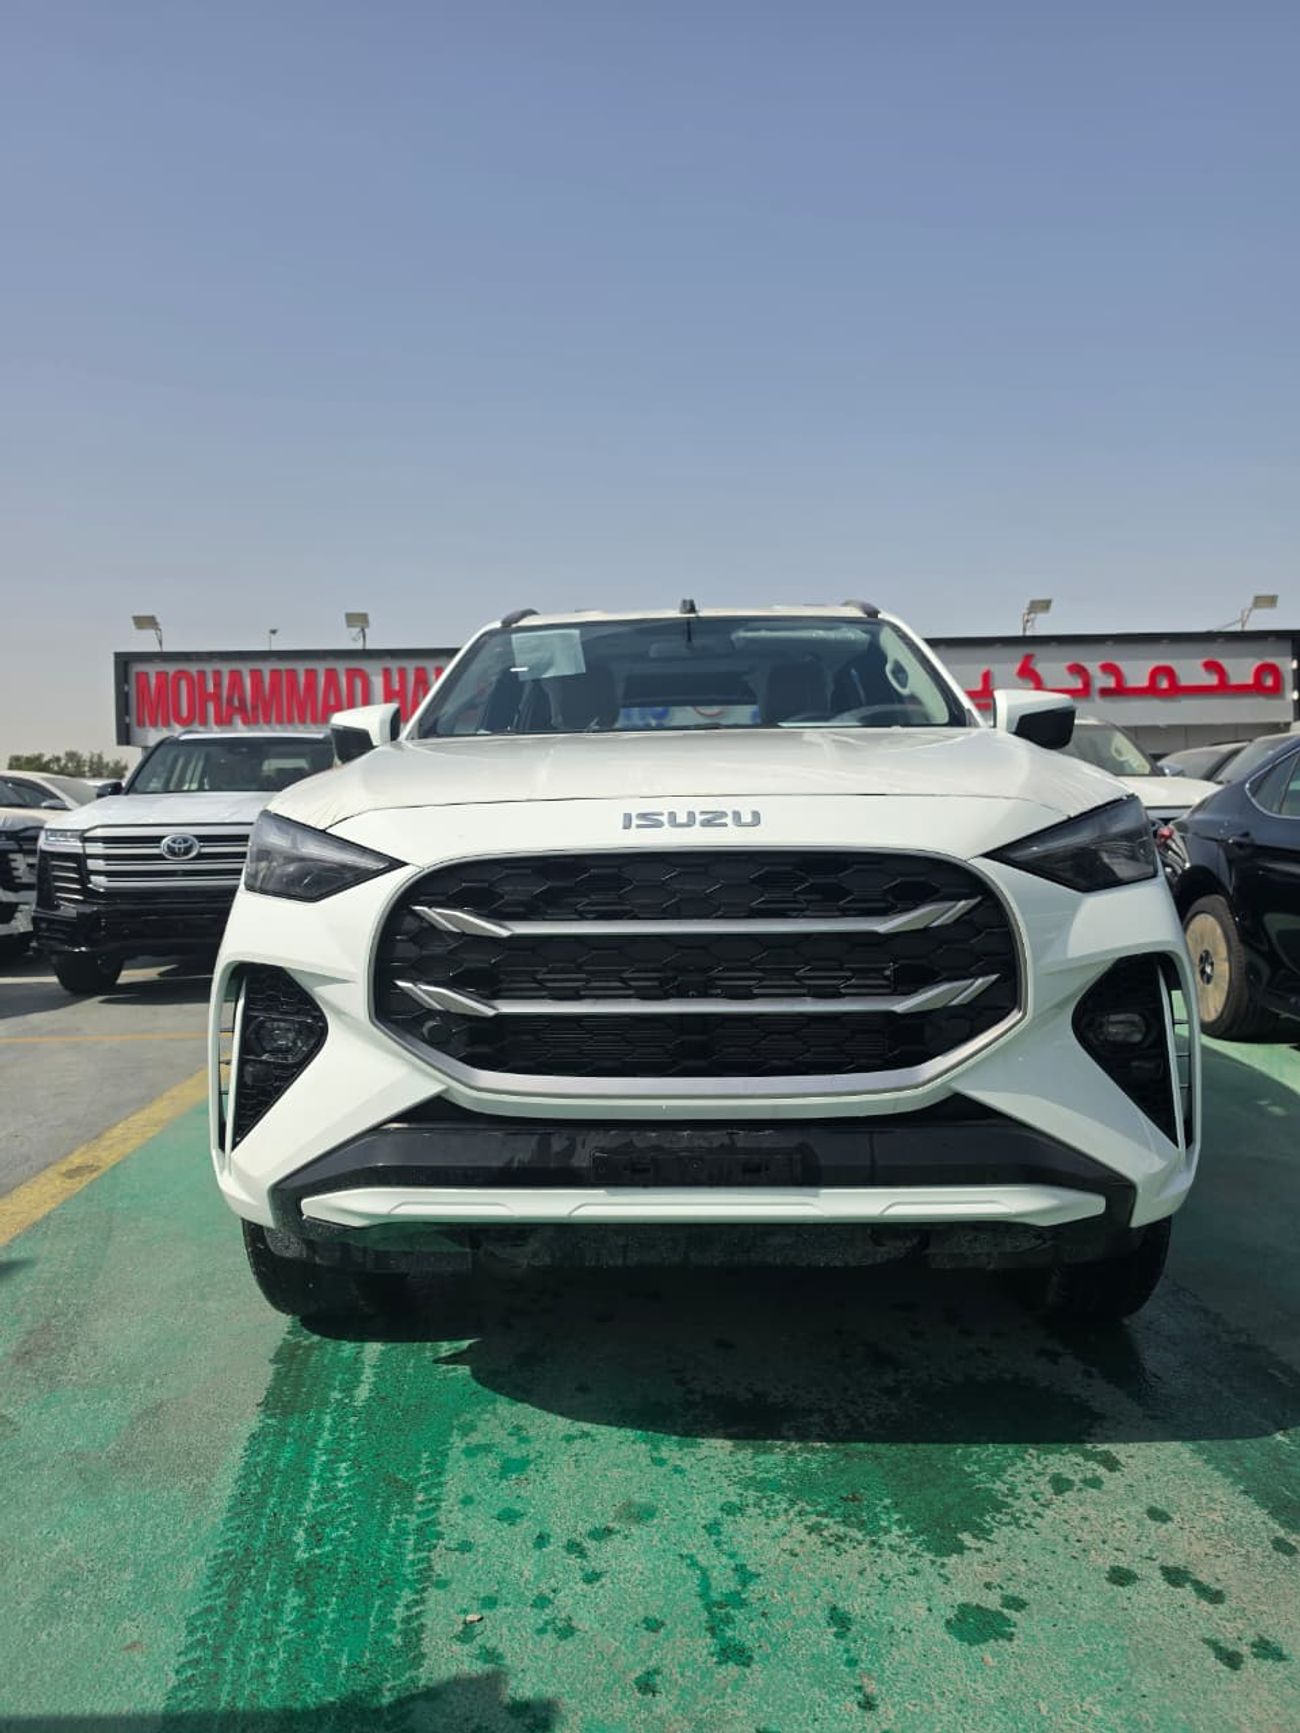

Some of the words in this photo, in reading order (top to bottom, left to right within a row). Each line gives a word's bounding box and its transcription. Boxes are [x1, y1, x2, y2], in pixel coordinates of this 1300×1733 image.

[135, 668, 371, 728] MOHAMMAD
[382, 665, 446, 724] HA
[1099, 659, 1282, 697] محمد
[622, 810, 761, 830] ISUZU
